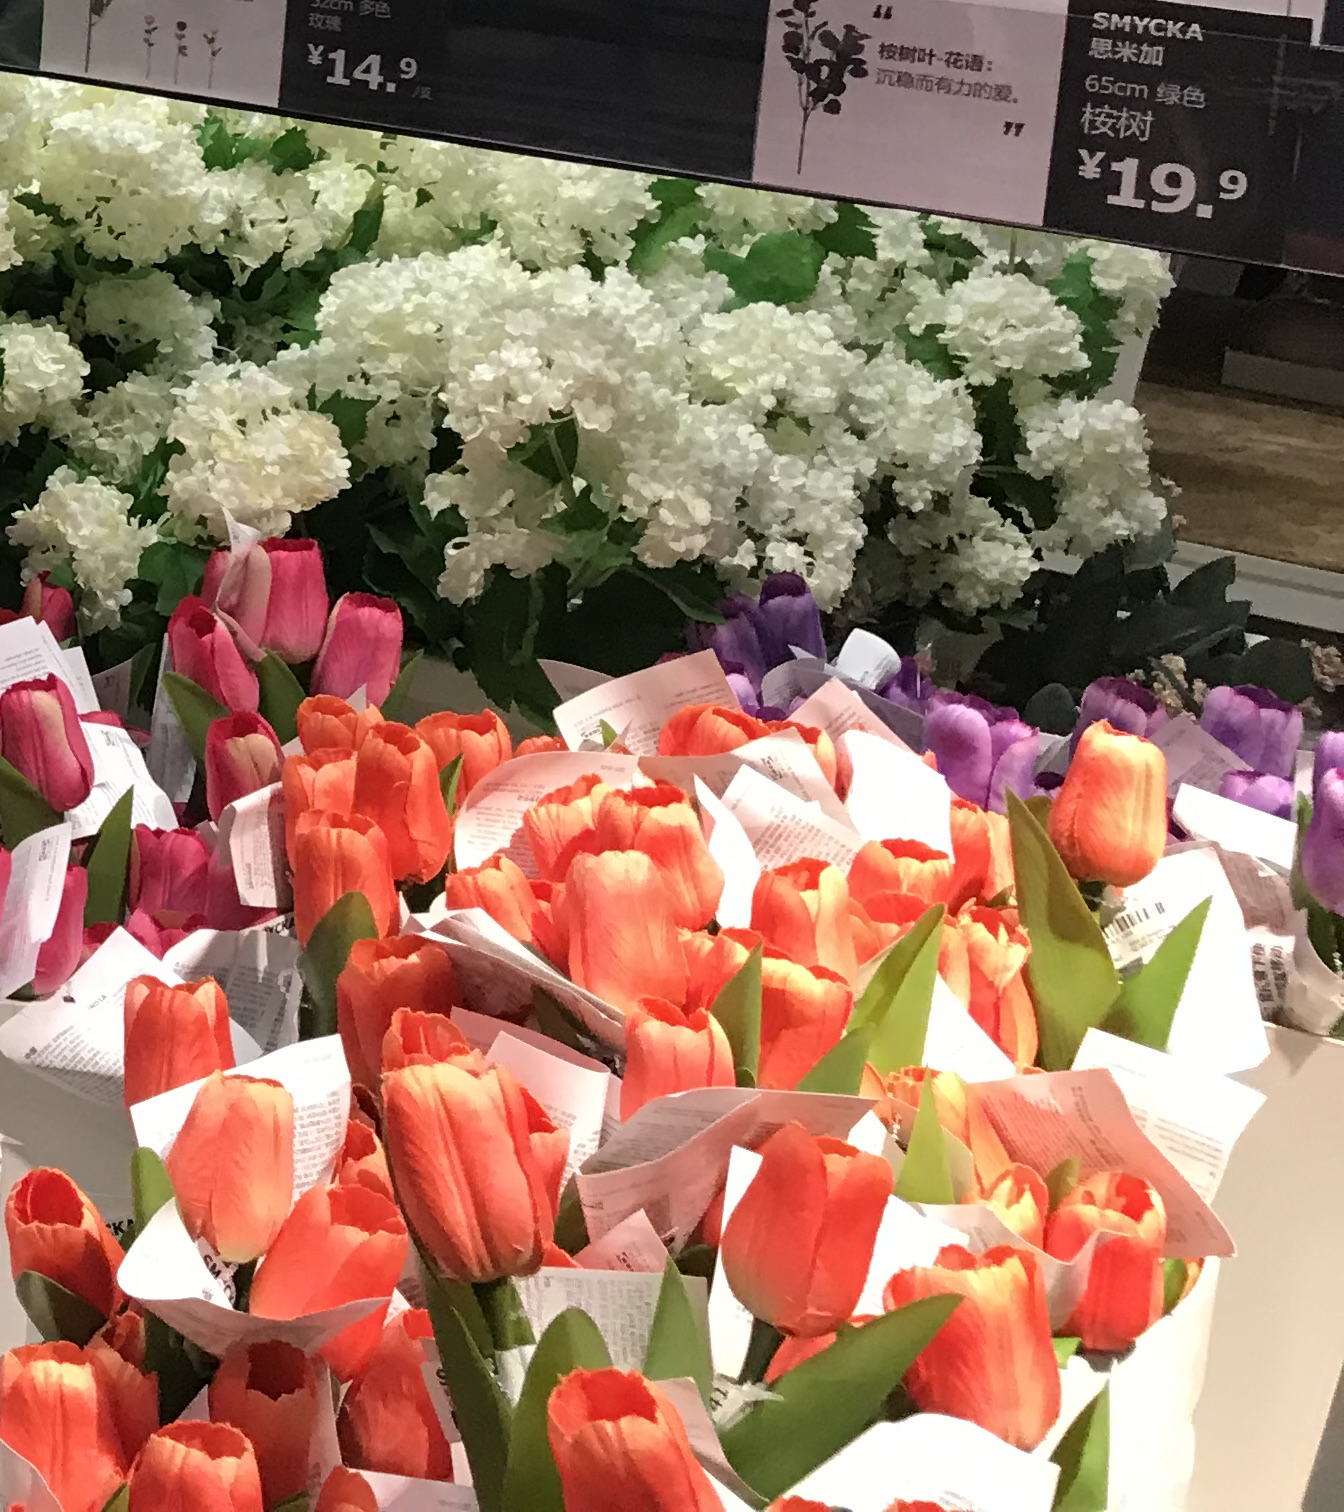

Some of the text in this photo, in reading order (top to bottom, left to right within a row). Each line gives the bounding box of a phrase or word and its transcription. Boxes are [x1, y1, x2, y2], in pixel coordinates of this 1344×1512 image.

[359, 0, 392, 19] 多色
[1092, 12, 1204, 41] SMYCKA
[307, 42, 418, 93] ¥14.9
[1088, 37, 1164, 67] 思米加
[1084, 75, 1207, 109] 65cm 绿色
[1081, 103, 1155, 142] 桉树
[1077, 149, 1249, 219] ¥19.9
[87, 994, 107, 1011] INDIA
